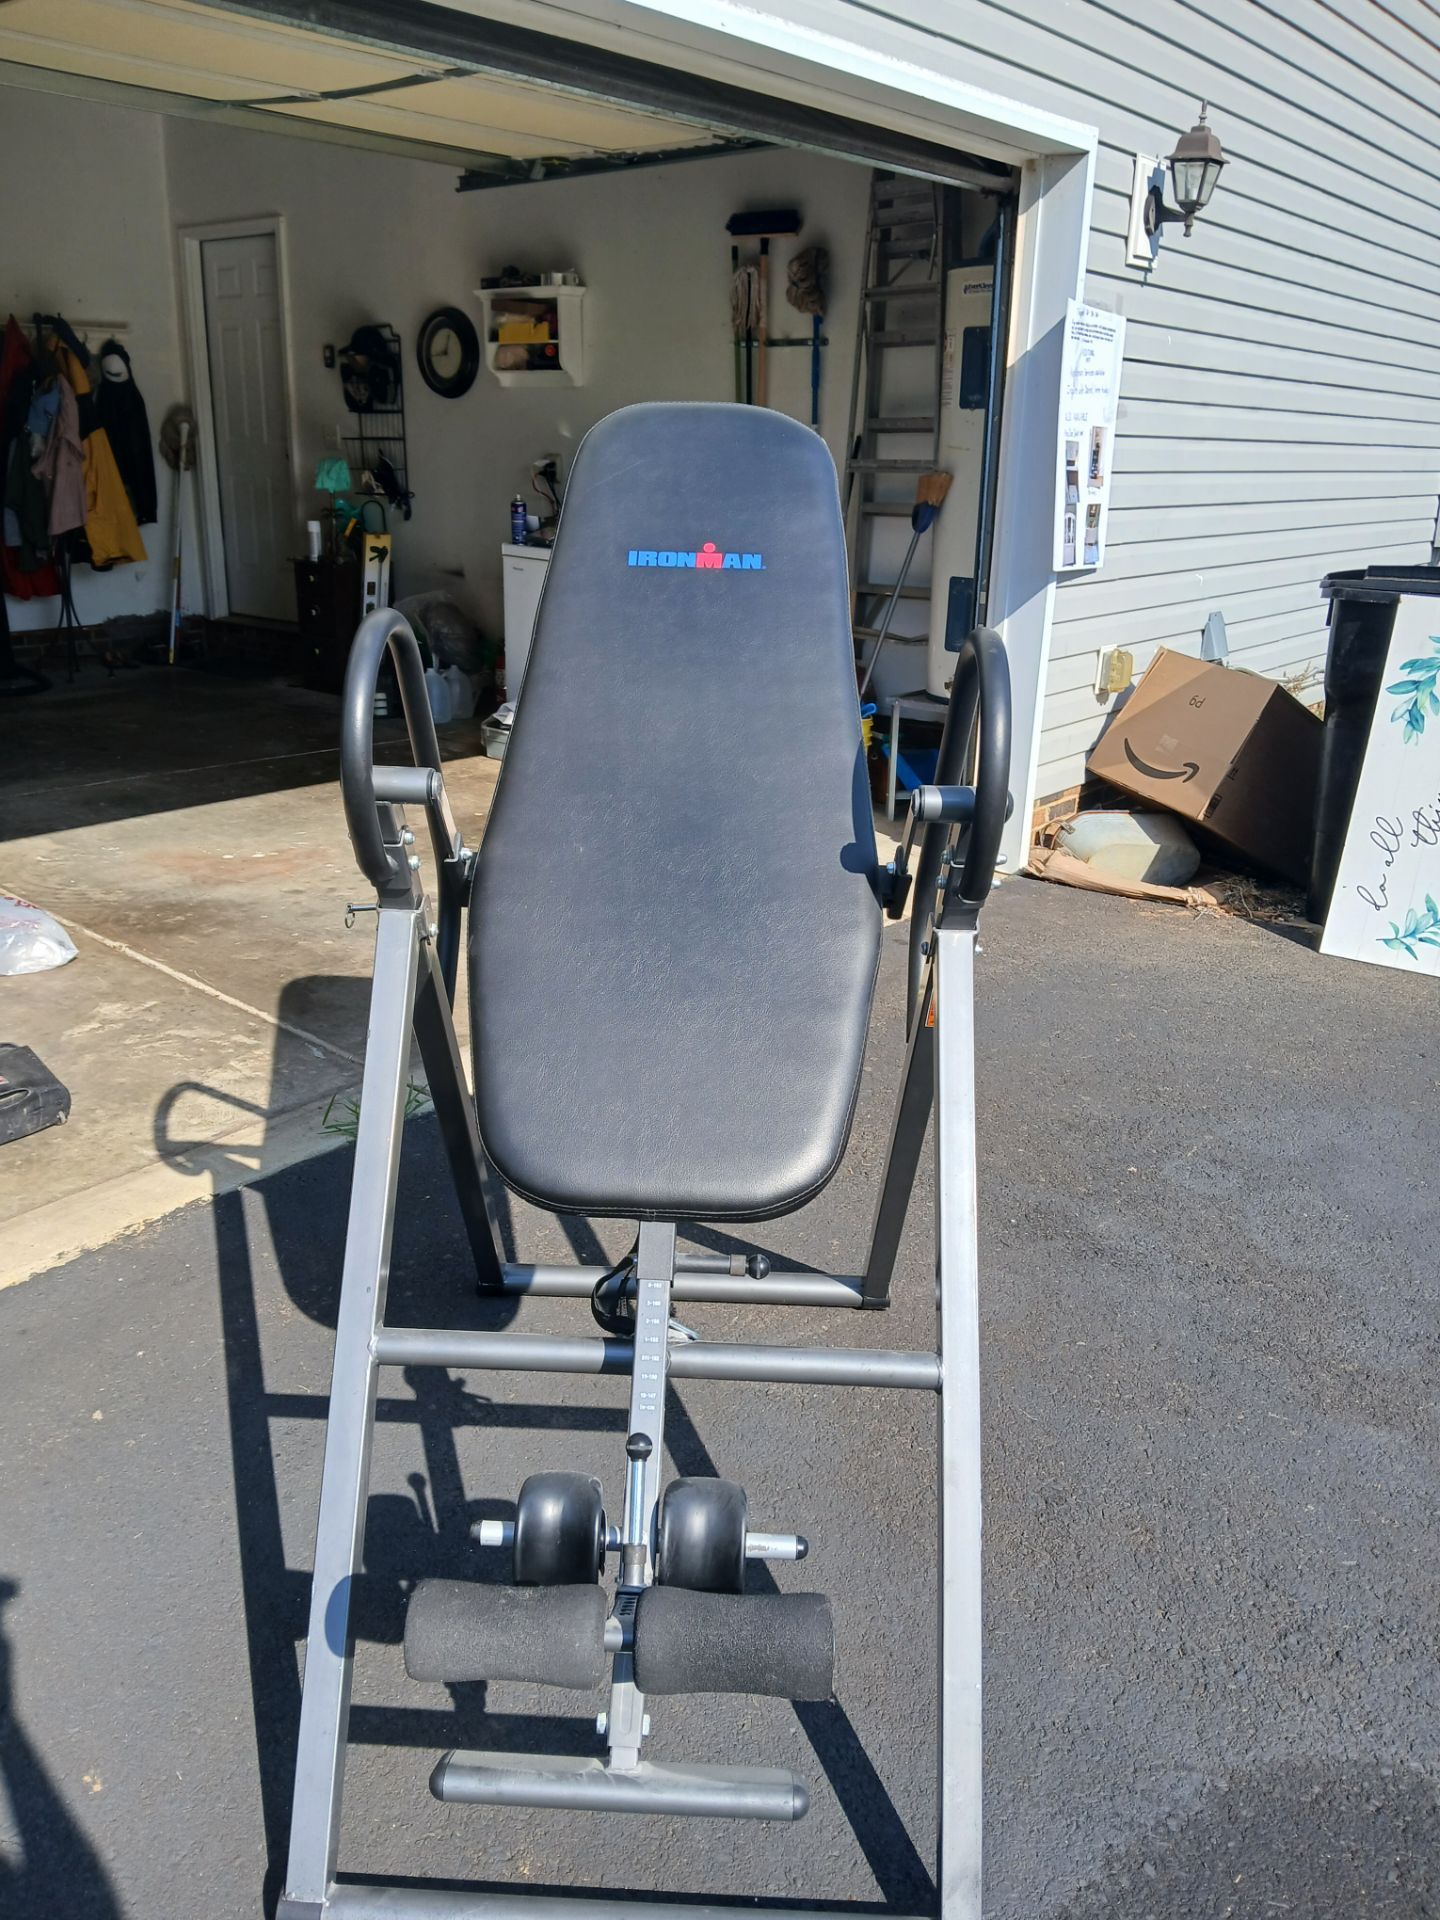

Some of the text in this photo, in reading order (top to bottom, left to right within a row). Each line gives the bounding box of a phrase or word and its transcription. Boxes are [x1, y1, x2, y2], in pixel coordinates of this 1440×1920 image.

[628, 543, 763, 569] IRONMAN
[1357, 817, 1403, 911] do all
